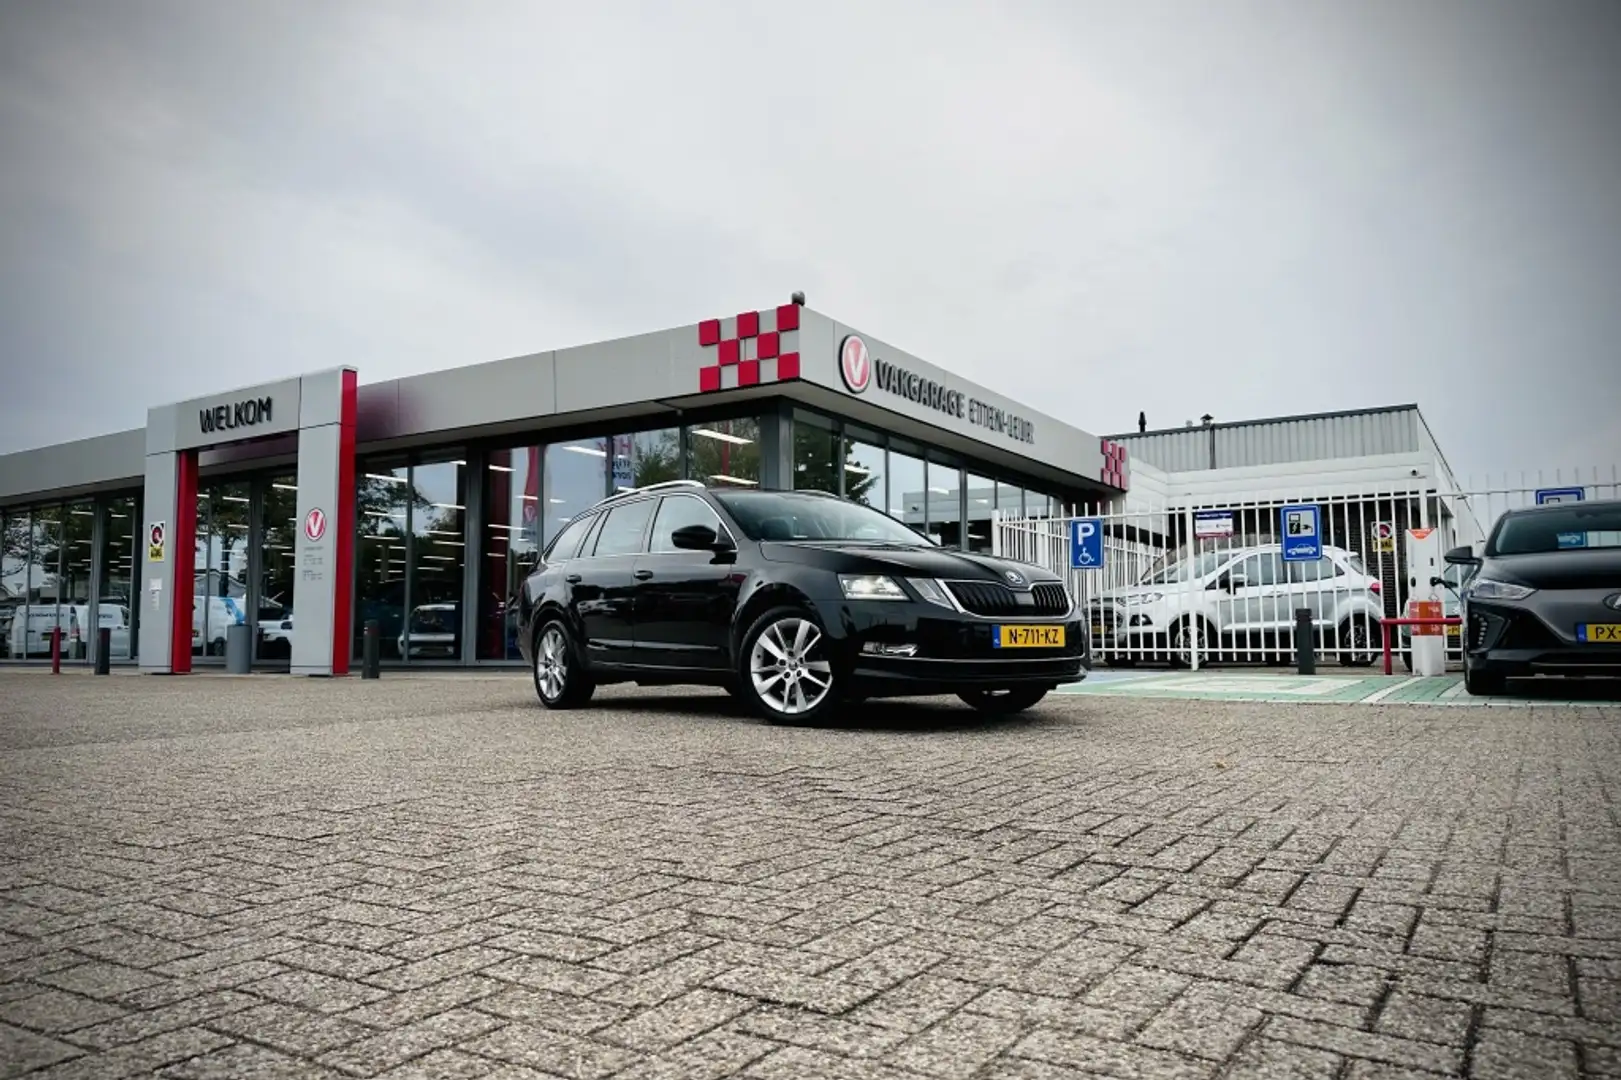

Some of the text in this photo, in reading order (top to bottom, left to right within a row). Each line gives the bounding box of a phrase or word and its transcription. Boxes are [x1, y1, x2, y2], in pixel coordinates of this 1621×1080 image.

[200, 396, 272, 433] WELKOM
[875, 358, 1034, 444] VAKGARAGE ETTEN-LEUR
[1078, 523, 1095, 545] P
[1009, 628, 1058, 644] N-711-KZ
